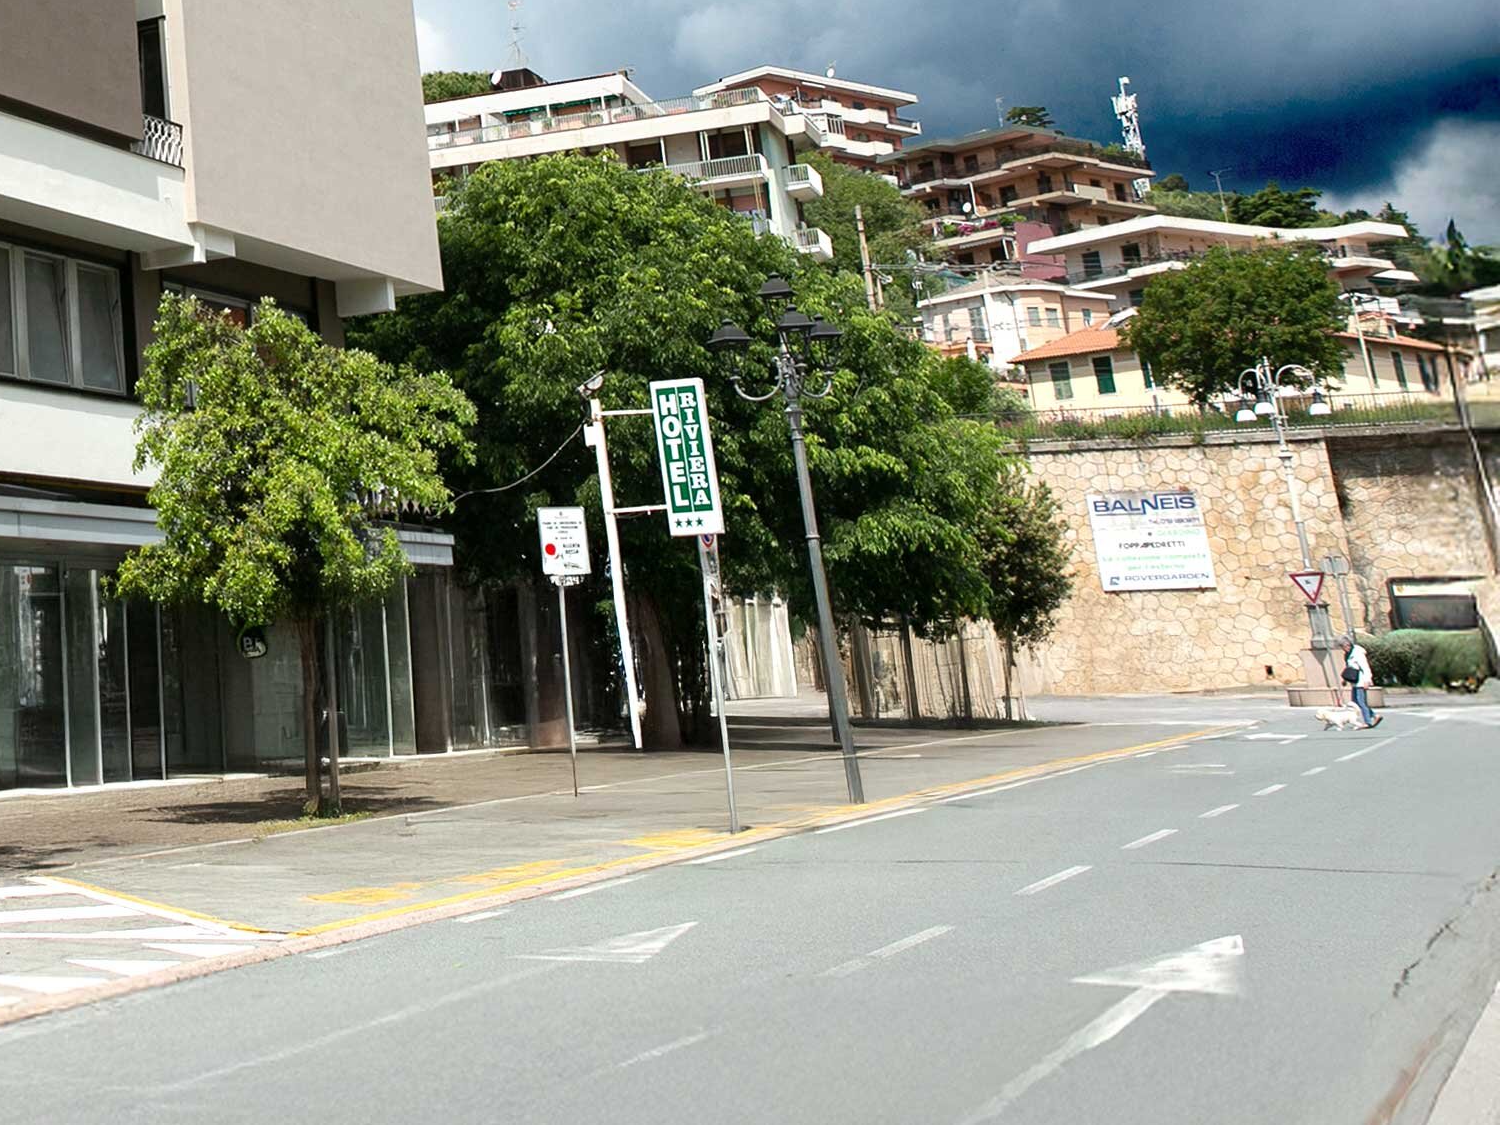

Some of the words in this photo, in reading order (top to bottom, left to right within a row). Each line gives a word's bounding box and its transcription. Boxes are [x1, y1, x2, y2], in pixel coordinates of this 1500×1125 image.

[658, 392, 690, 507] HOTEL
[678, 391, 711, 506] RIVIERA
[1093, 492, 1197, 515] BALNEIS
